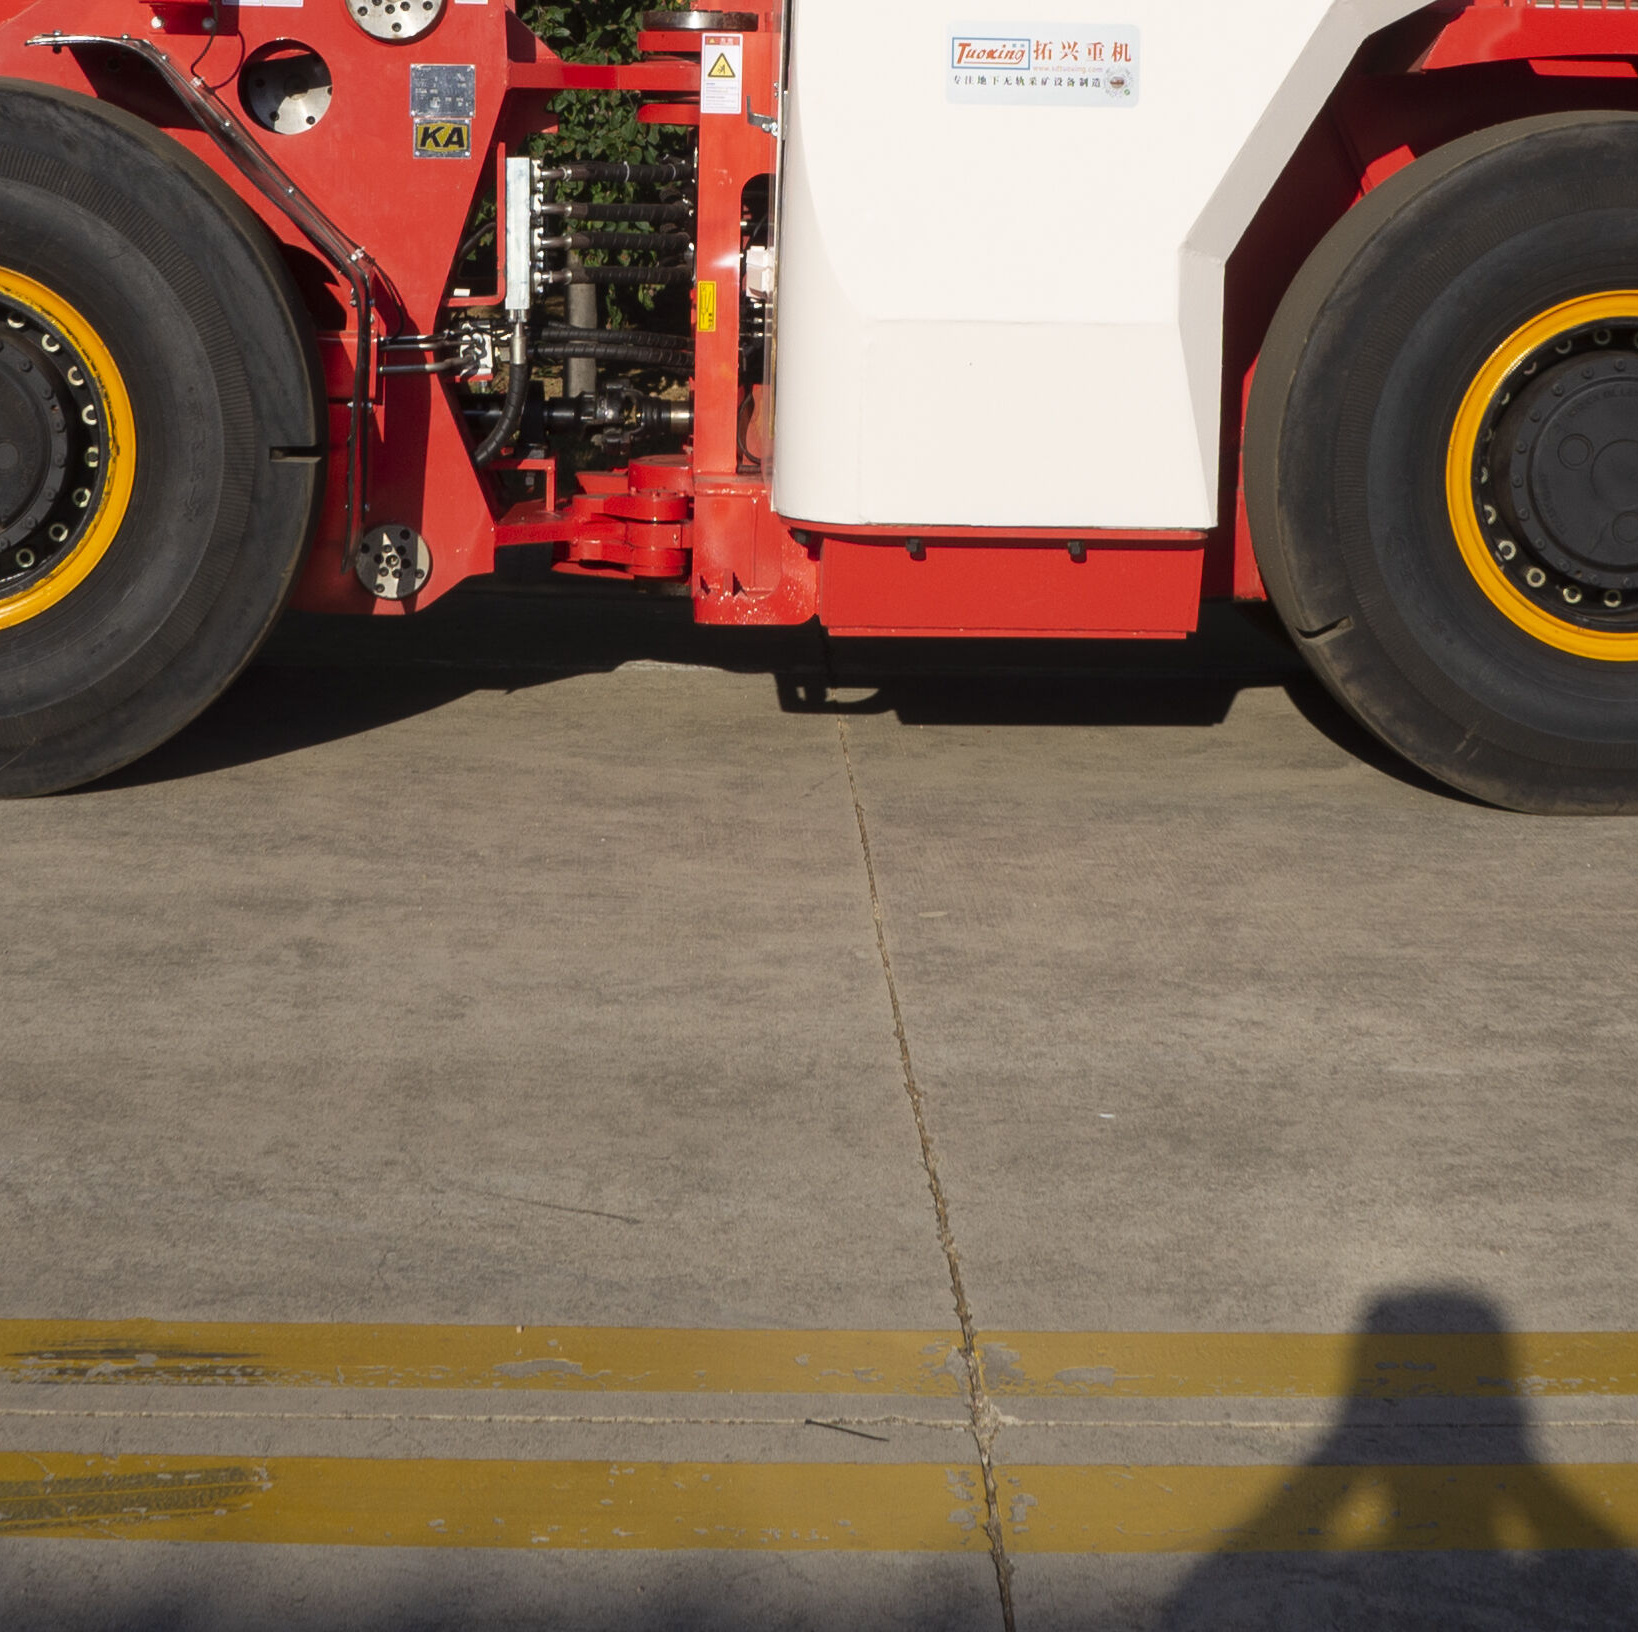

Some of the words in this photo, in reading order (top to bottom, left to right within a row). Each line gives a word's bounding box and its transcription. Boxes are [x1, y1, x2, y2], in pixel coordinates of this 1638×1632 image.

[957, 42, 1026, 65] Tuoxing
[1033, 40, 1132, 62] 拓兴重机
[419, 126, 466, 149] KA
